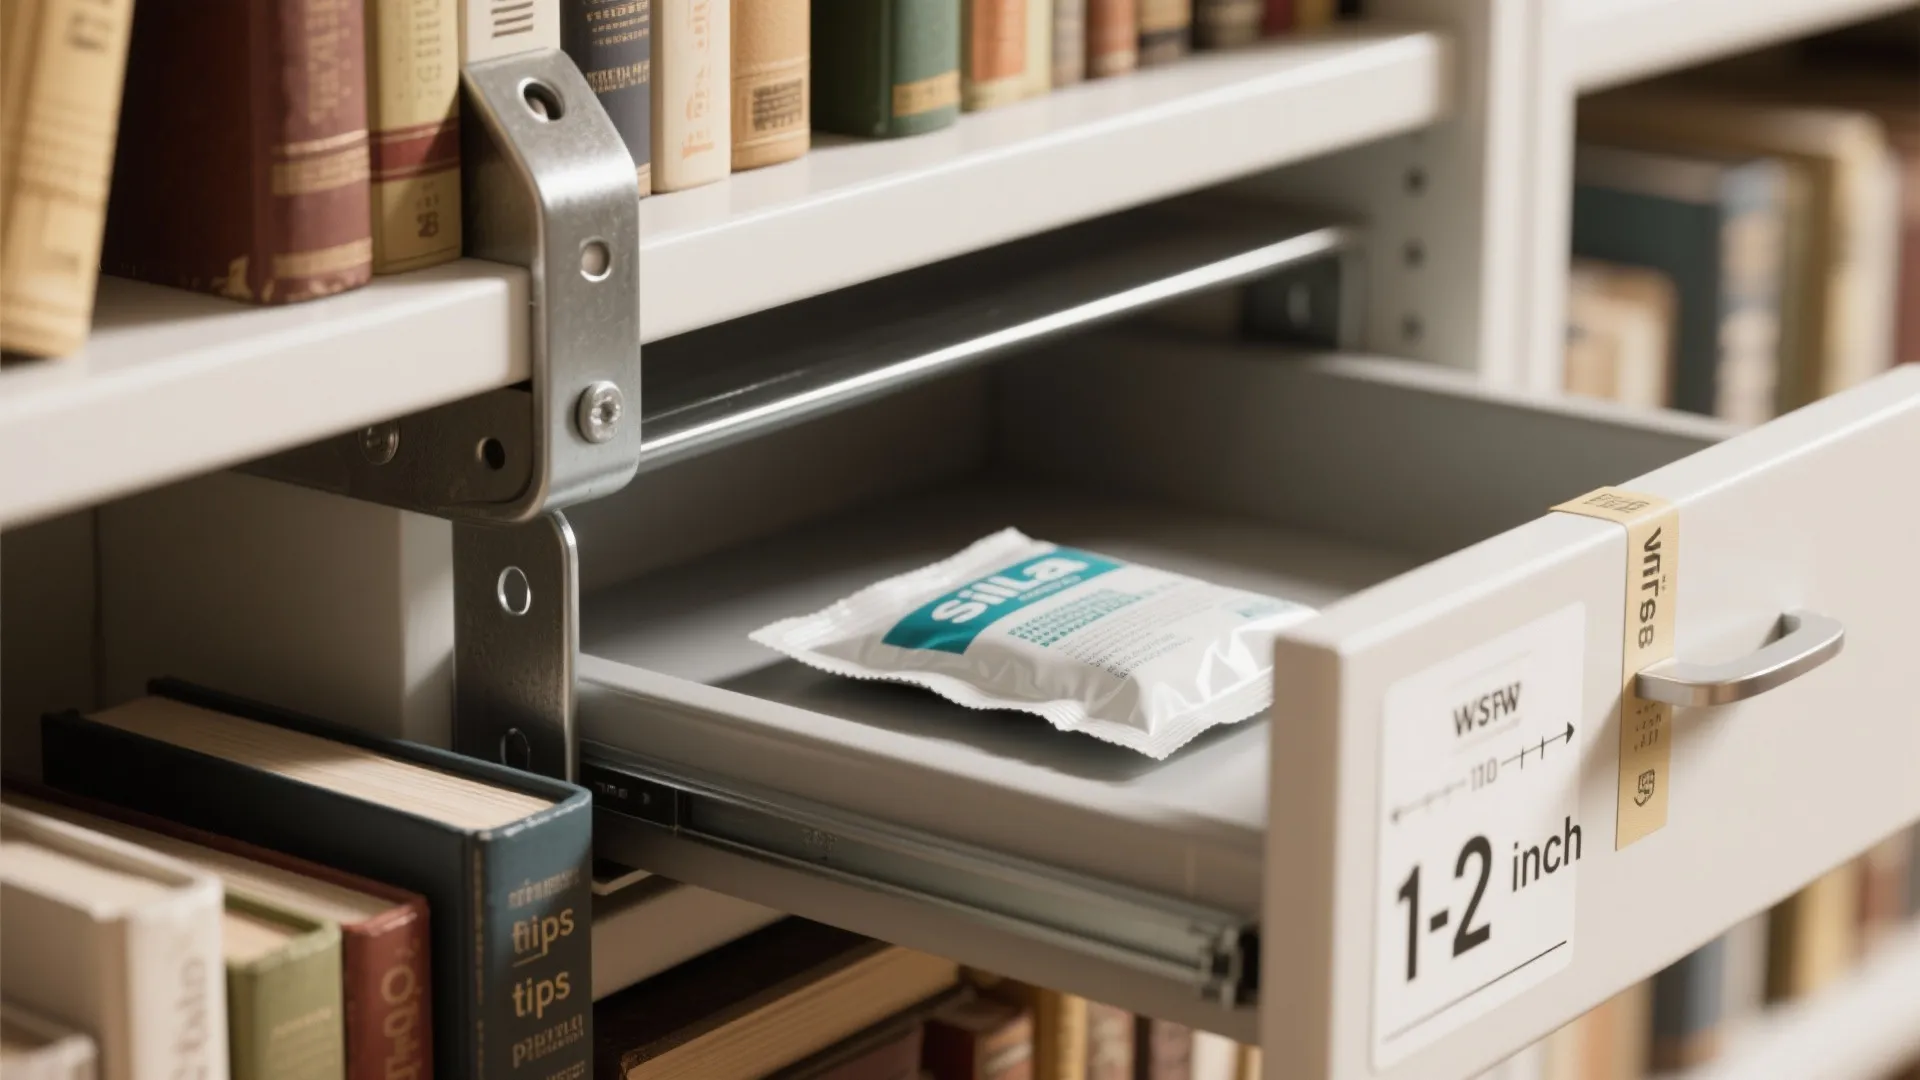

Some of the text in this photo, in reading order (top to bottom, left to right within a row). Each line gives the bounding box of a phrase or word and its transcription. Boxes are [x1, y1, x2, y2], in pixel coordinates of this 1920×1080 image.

[1396, 815, 1583, 982] 1-2 inch
[512, 970, 570, 1018] tips
